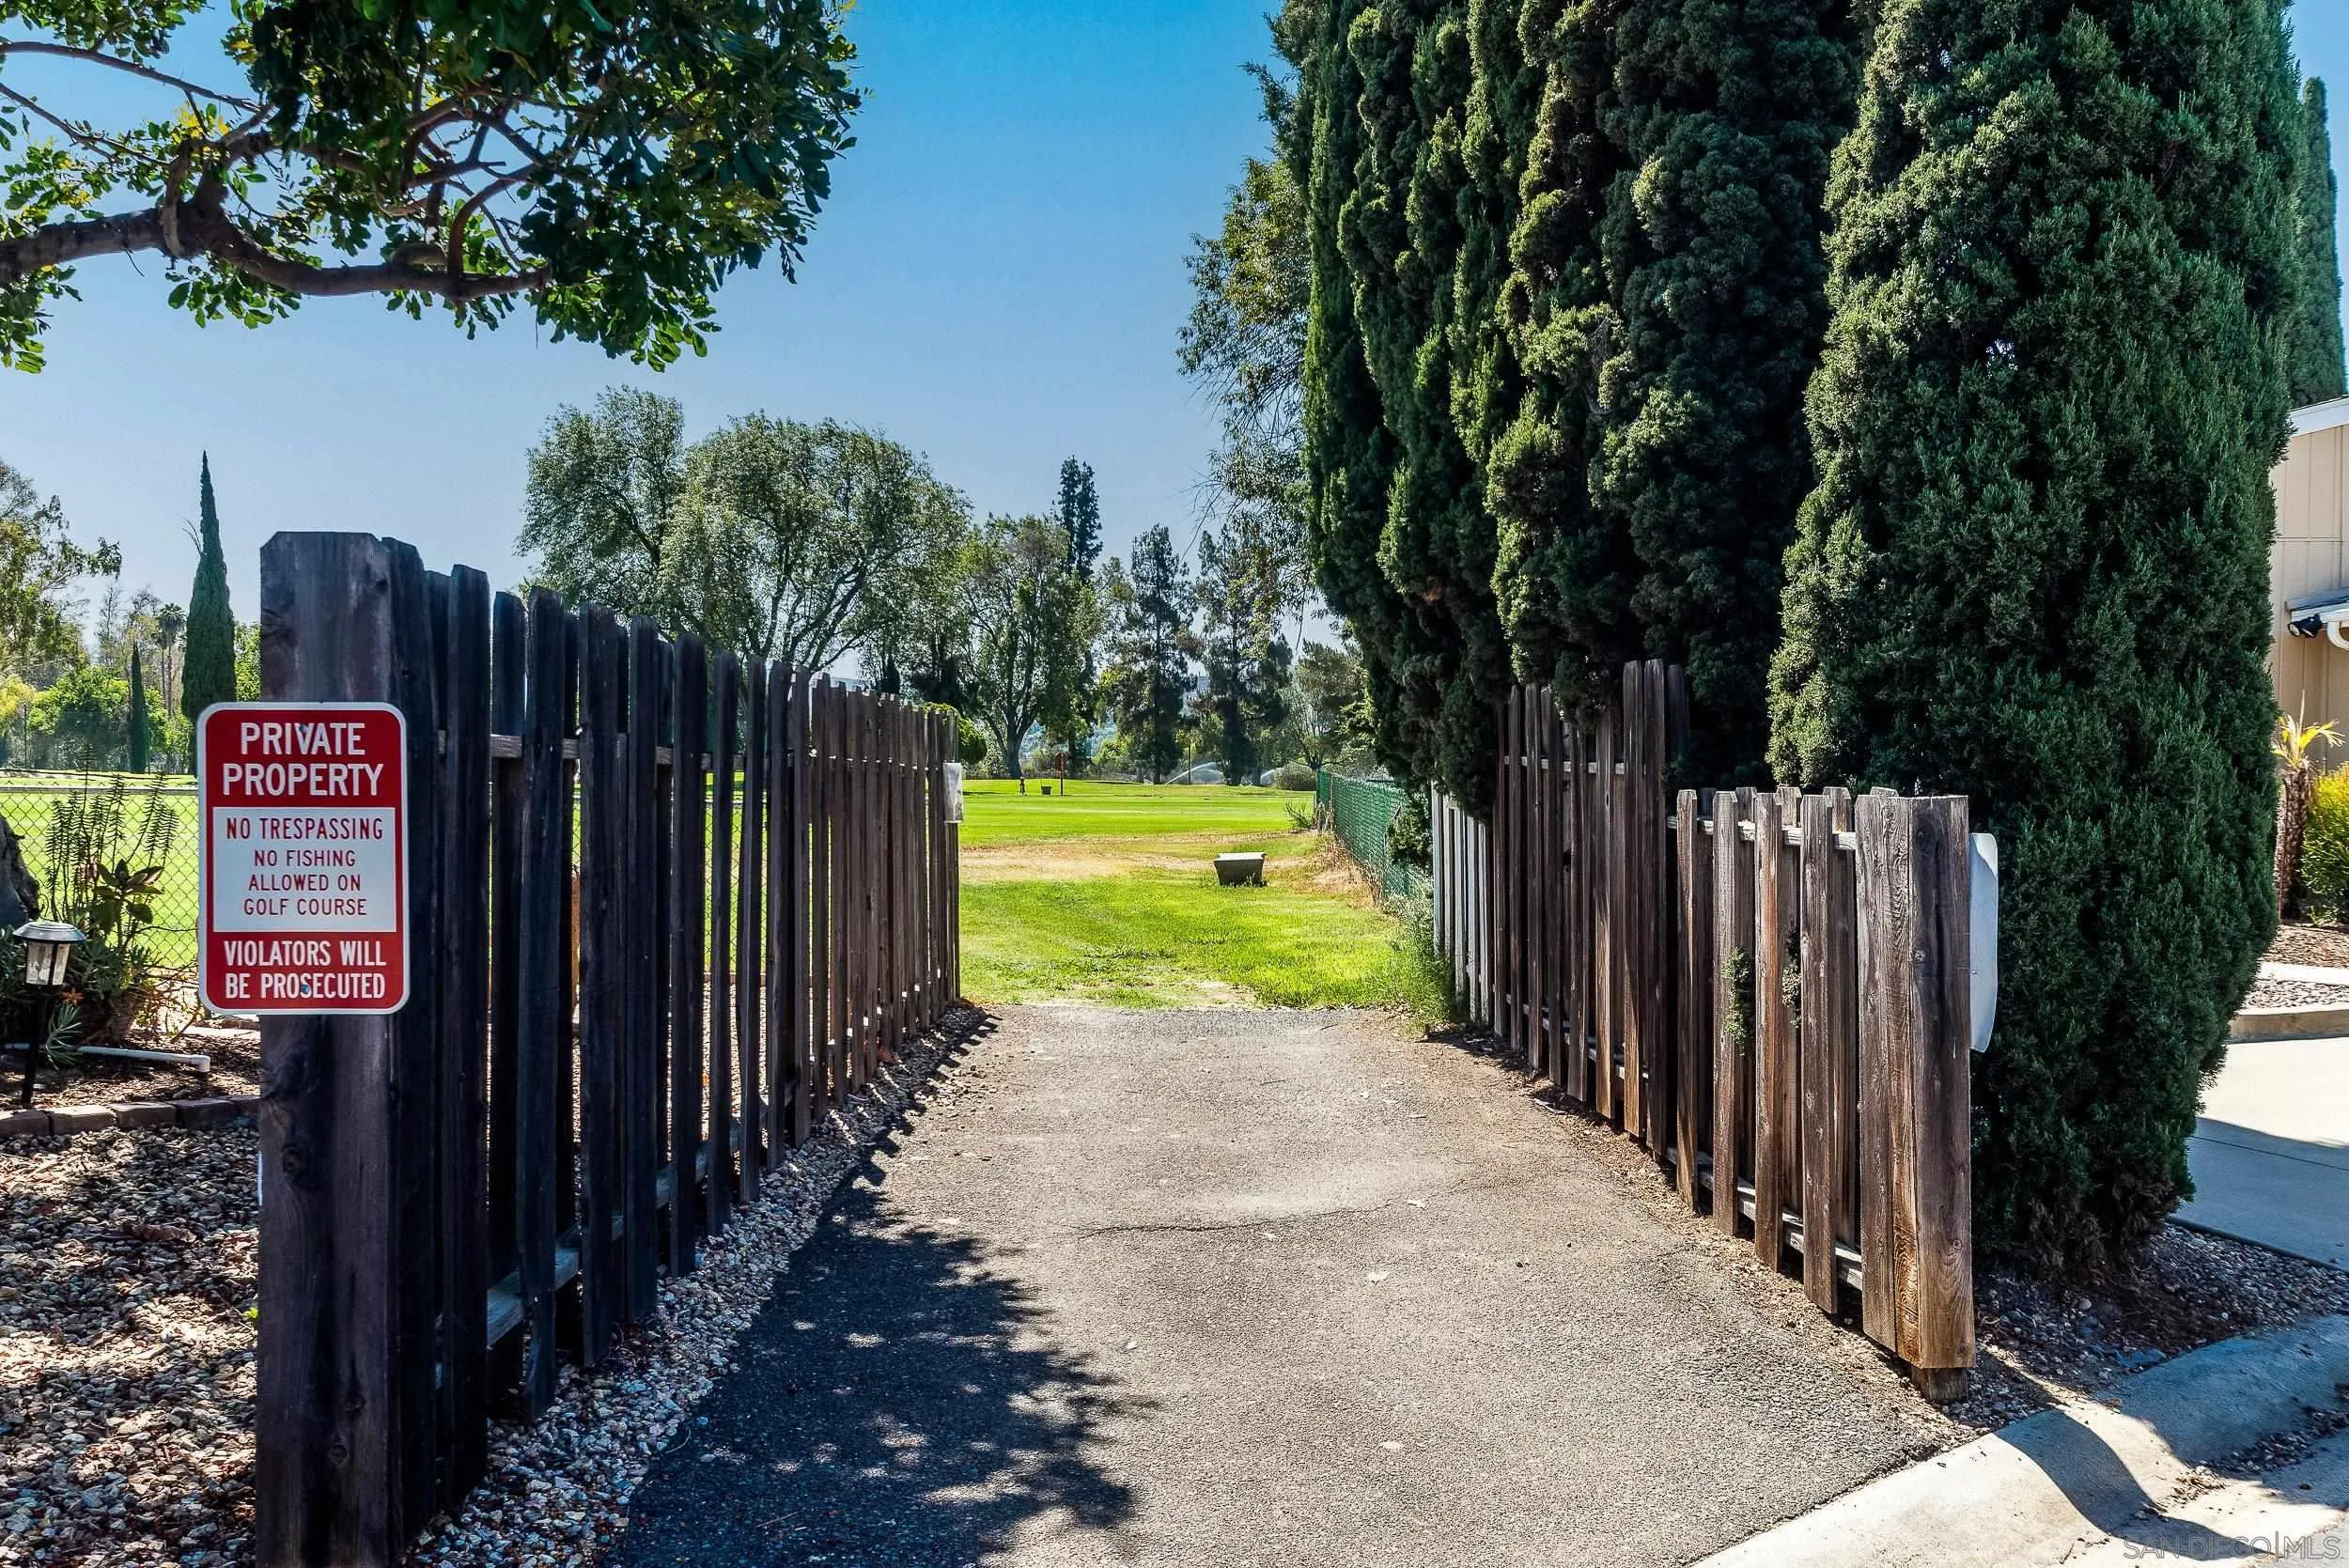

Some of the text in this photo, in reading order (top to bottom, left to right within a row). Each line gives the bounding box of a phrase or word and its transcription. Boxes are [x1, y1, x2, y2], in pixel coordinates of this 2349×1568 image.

[241, 722, 366, 755] PRIVATE
[223, 763, 383, 797] PROPERTY
[226, 817, 383, 840] NO TRESPASSING
[254, 849, 356, 867] NO FISHING
[248, 874, 361, 892] ALLOWED ON
[243, 898, 367, 916] GOLF COURSE
[224, 940, 387, 967] VIOLATORS WILL
[226, 973, 385, 999] BE PROSECUTED
